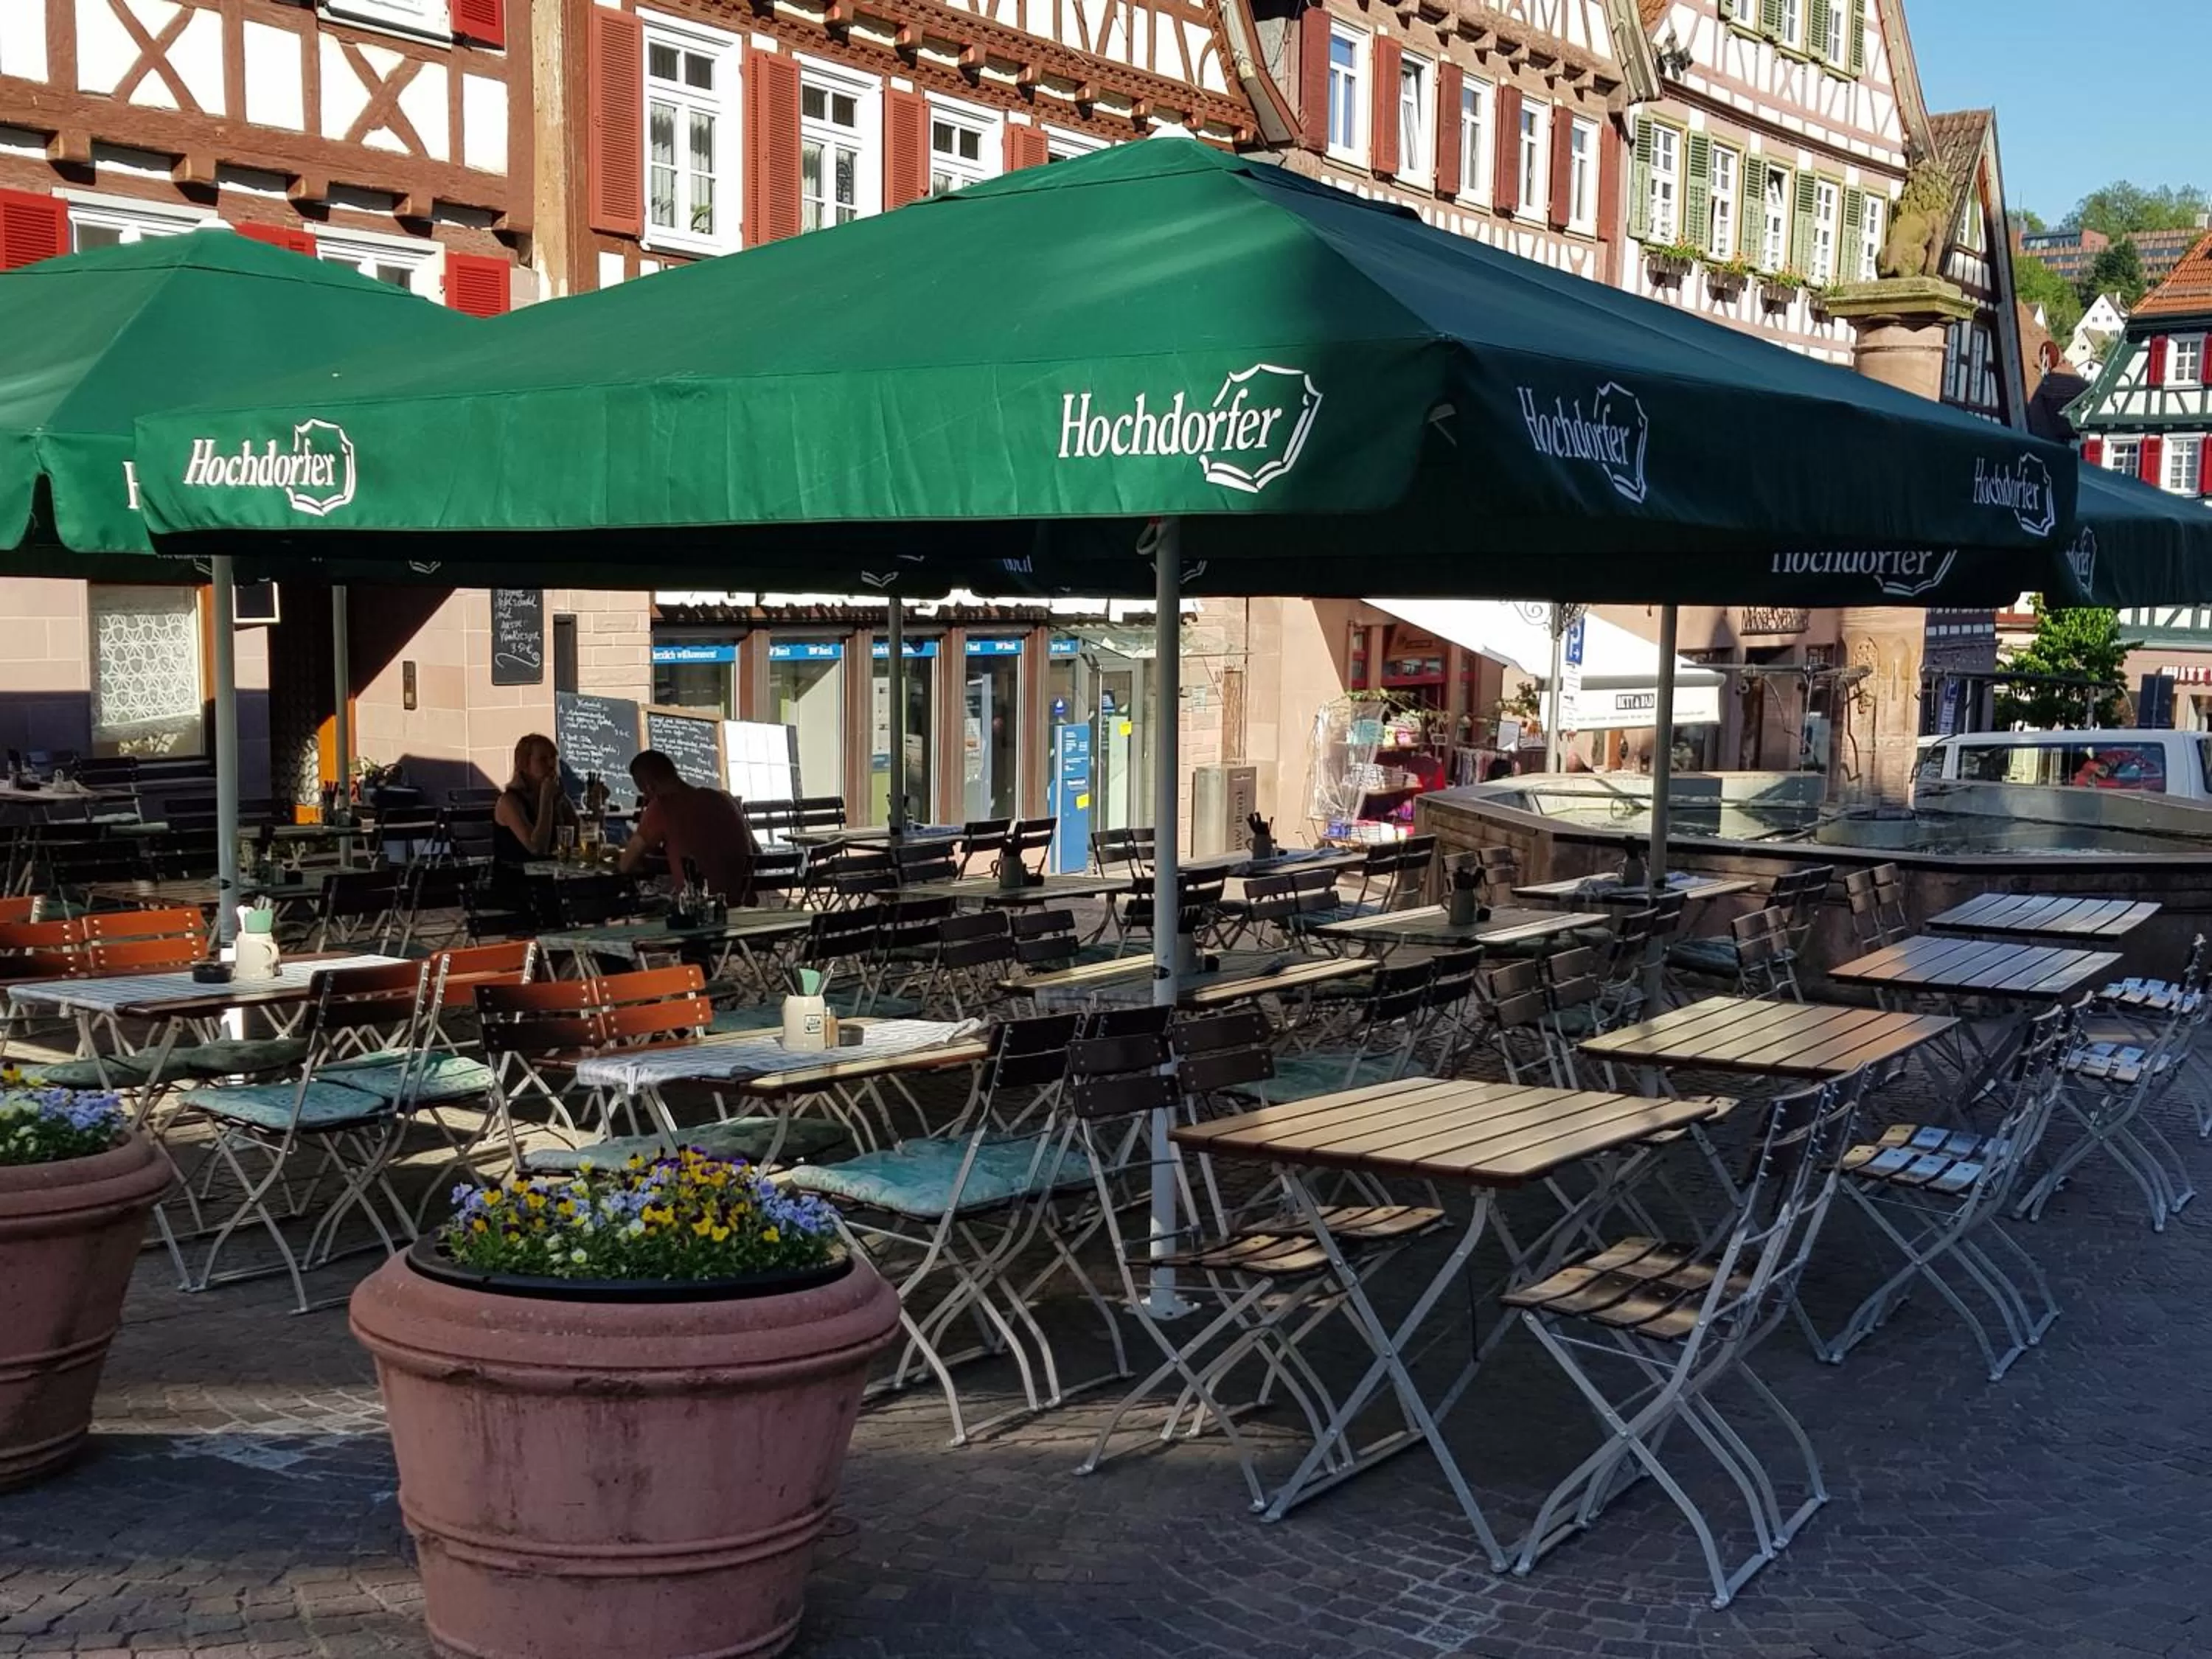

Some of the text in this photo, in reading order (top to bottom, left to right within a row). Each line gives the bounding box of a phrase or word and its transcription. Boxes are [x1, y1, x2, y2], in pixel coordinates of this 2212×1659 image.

[1058, 388, 1283, 459] Hochdorfer
[1517, 386, 1630, 465] Hochdorfer
[183, 438, 335, 487] Hochdorfer
[1973, 456, 2039, 510] Hochdorfer
